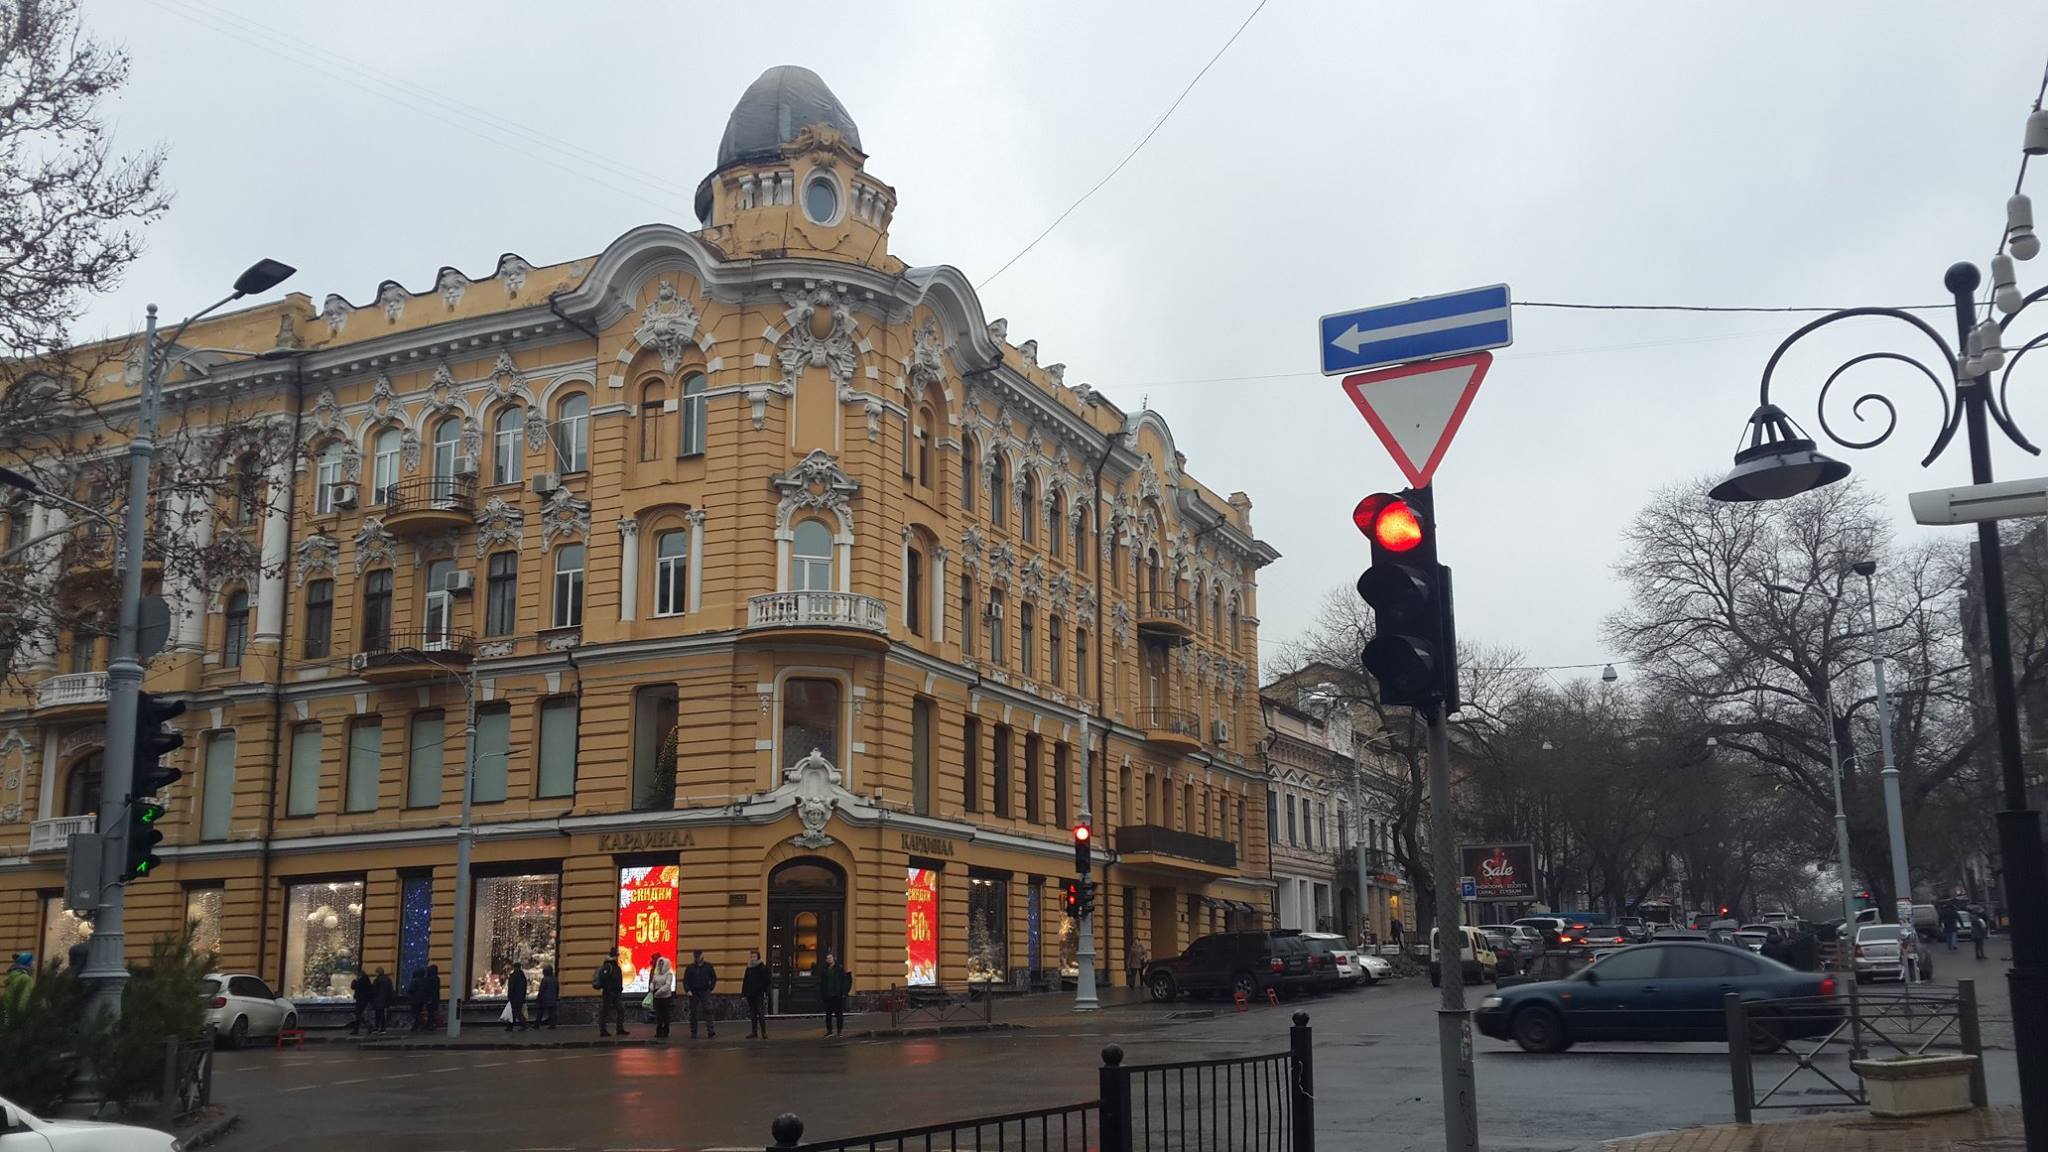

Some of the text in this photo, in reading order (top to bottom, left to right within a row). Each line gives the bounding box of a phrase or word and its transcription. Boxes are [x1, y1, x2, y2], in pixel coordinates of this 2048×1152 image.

[598, 829, 695, 851] КАРДИНАЛ
[1482, 859, 1514, 877] Sale
[630, 887, 672, 902] СКИДКИ
[1464, 884, 1473, 895] P
[628, 912, 671, 944] -50%
